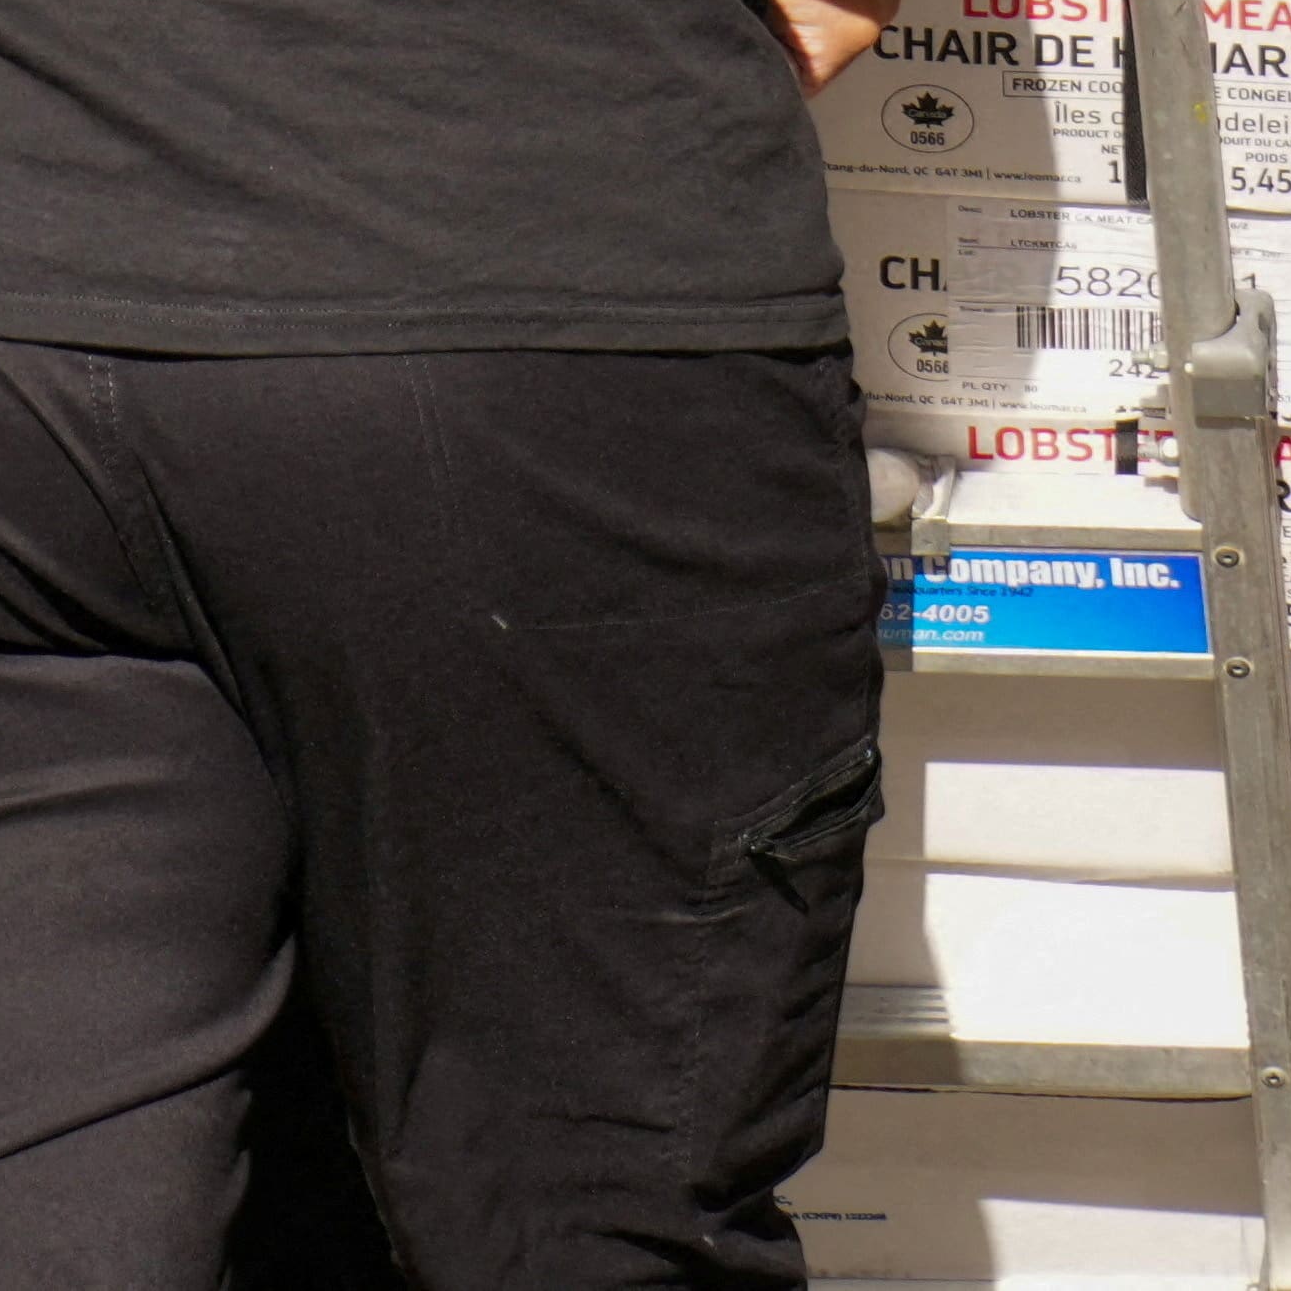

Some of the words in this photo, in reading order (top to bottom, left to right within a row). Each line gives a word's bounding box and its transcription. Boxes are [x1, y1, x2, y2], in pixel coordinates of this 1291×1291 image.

[872, 24, 1019, 66] CHAIR
[1034, 33, 1095, 68] DE
[1012, 77, 1082, 93] FROZEN
[1054, 100, 1101, 125] Îles
[910, 130, 945, 146] 0566
[1052, 127, 1110, 139] PRODUCT
[1245, 151, 1288, 165] POIDS
[1010, 208, 1071, 223] LOBSTER
[922, 556, 1106, 589] Company,
[1108, 556, 1182, 589] Inc.
[879, 603, 990, 624] 62-4005
